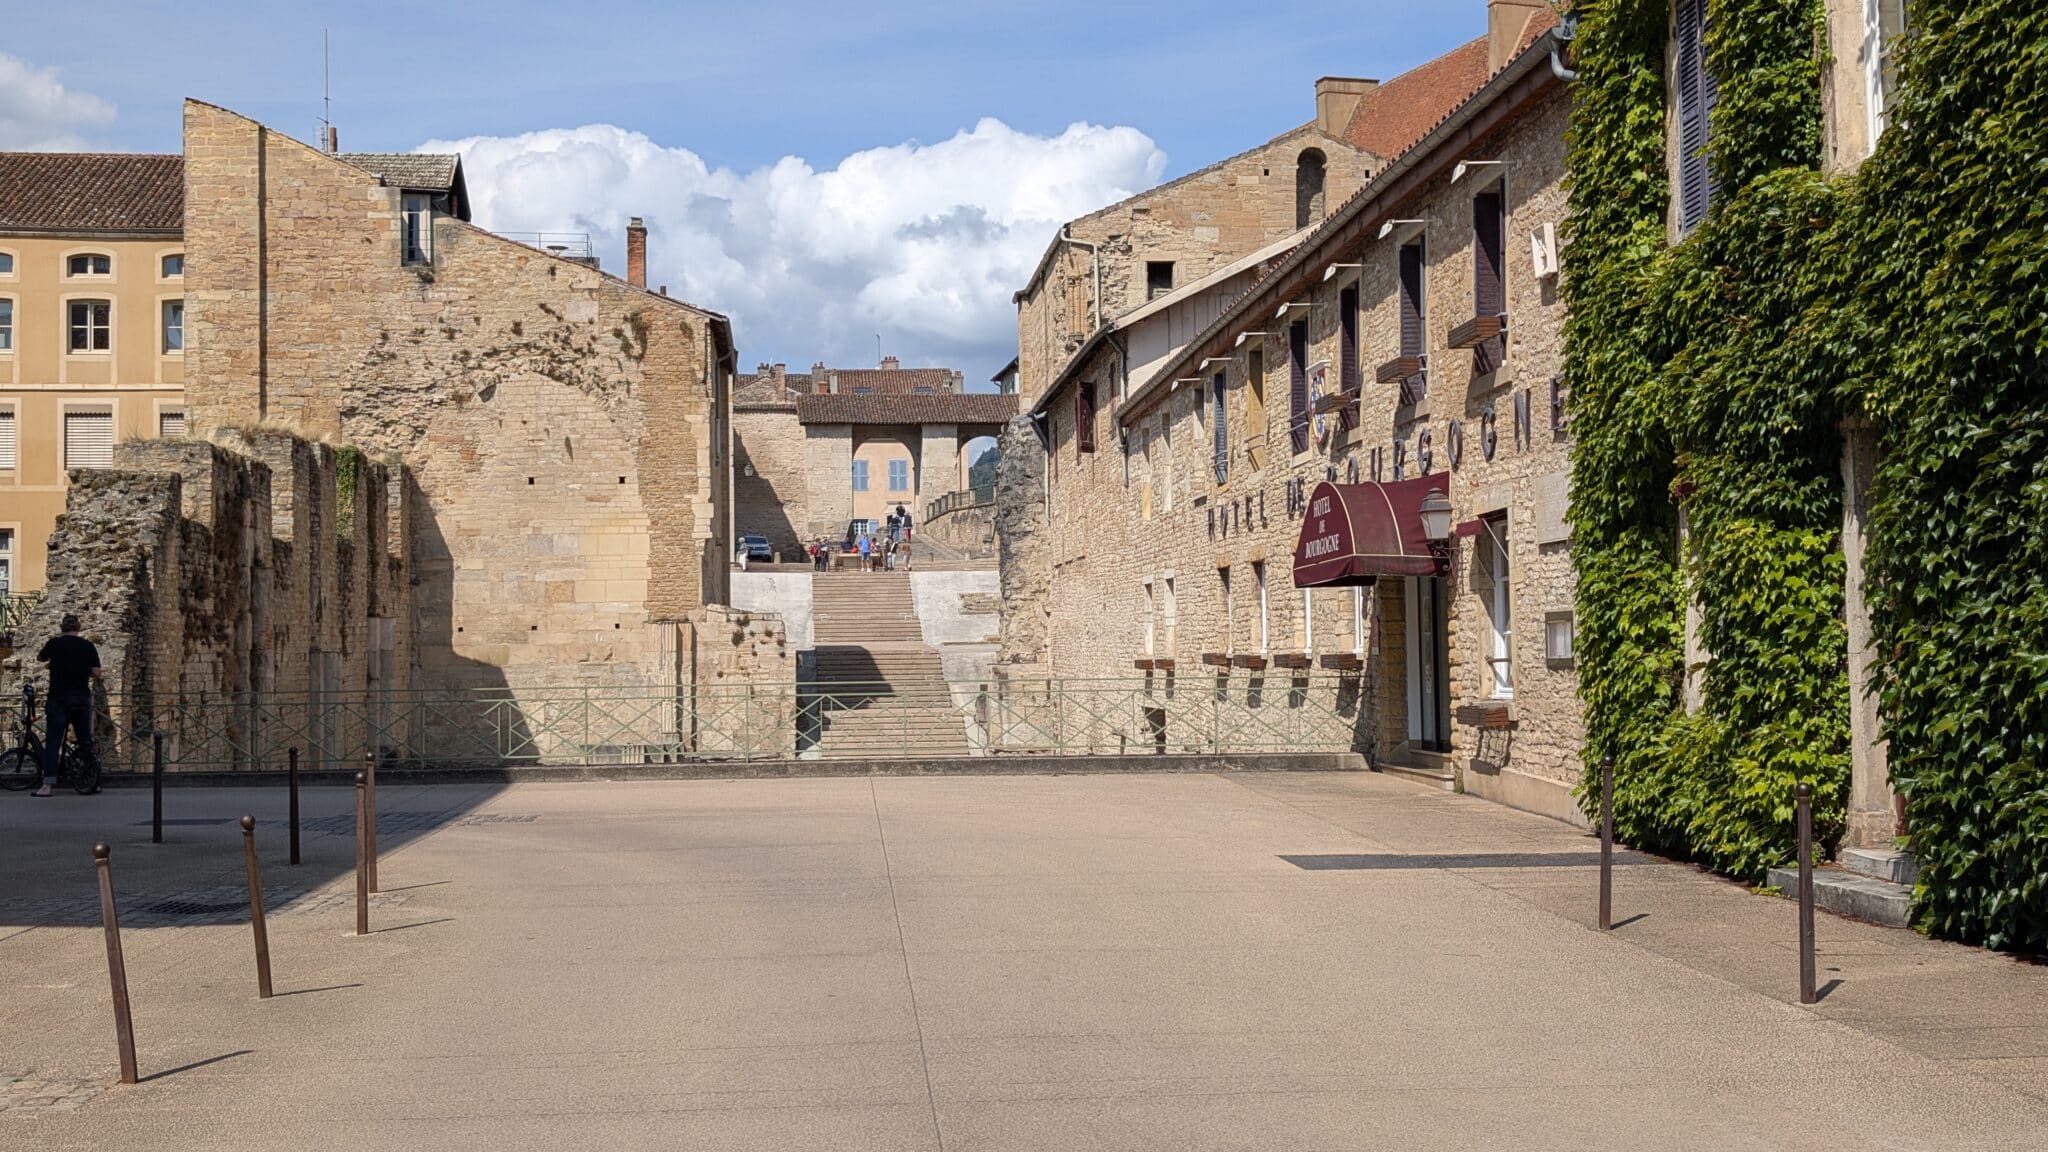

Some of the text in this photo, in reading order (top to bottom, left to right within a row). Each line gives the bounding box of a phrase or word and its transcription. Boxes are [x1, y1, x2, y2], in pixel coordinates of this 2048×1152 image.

[1207, 489, 1267, 537] HOTEL
[1286, 475, 1306, 515] DE
[1313, 496, 1331, 518] HOTEL
[1319, 520, 1326, 534] DE
[1305, 534, 1340, 559] BOURGOGNE
